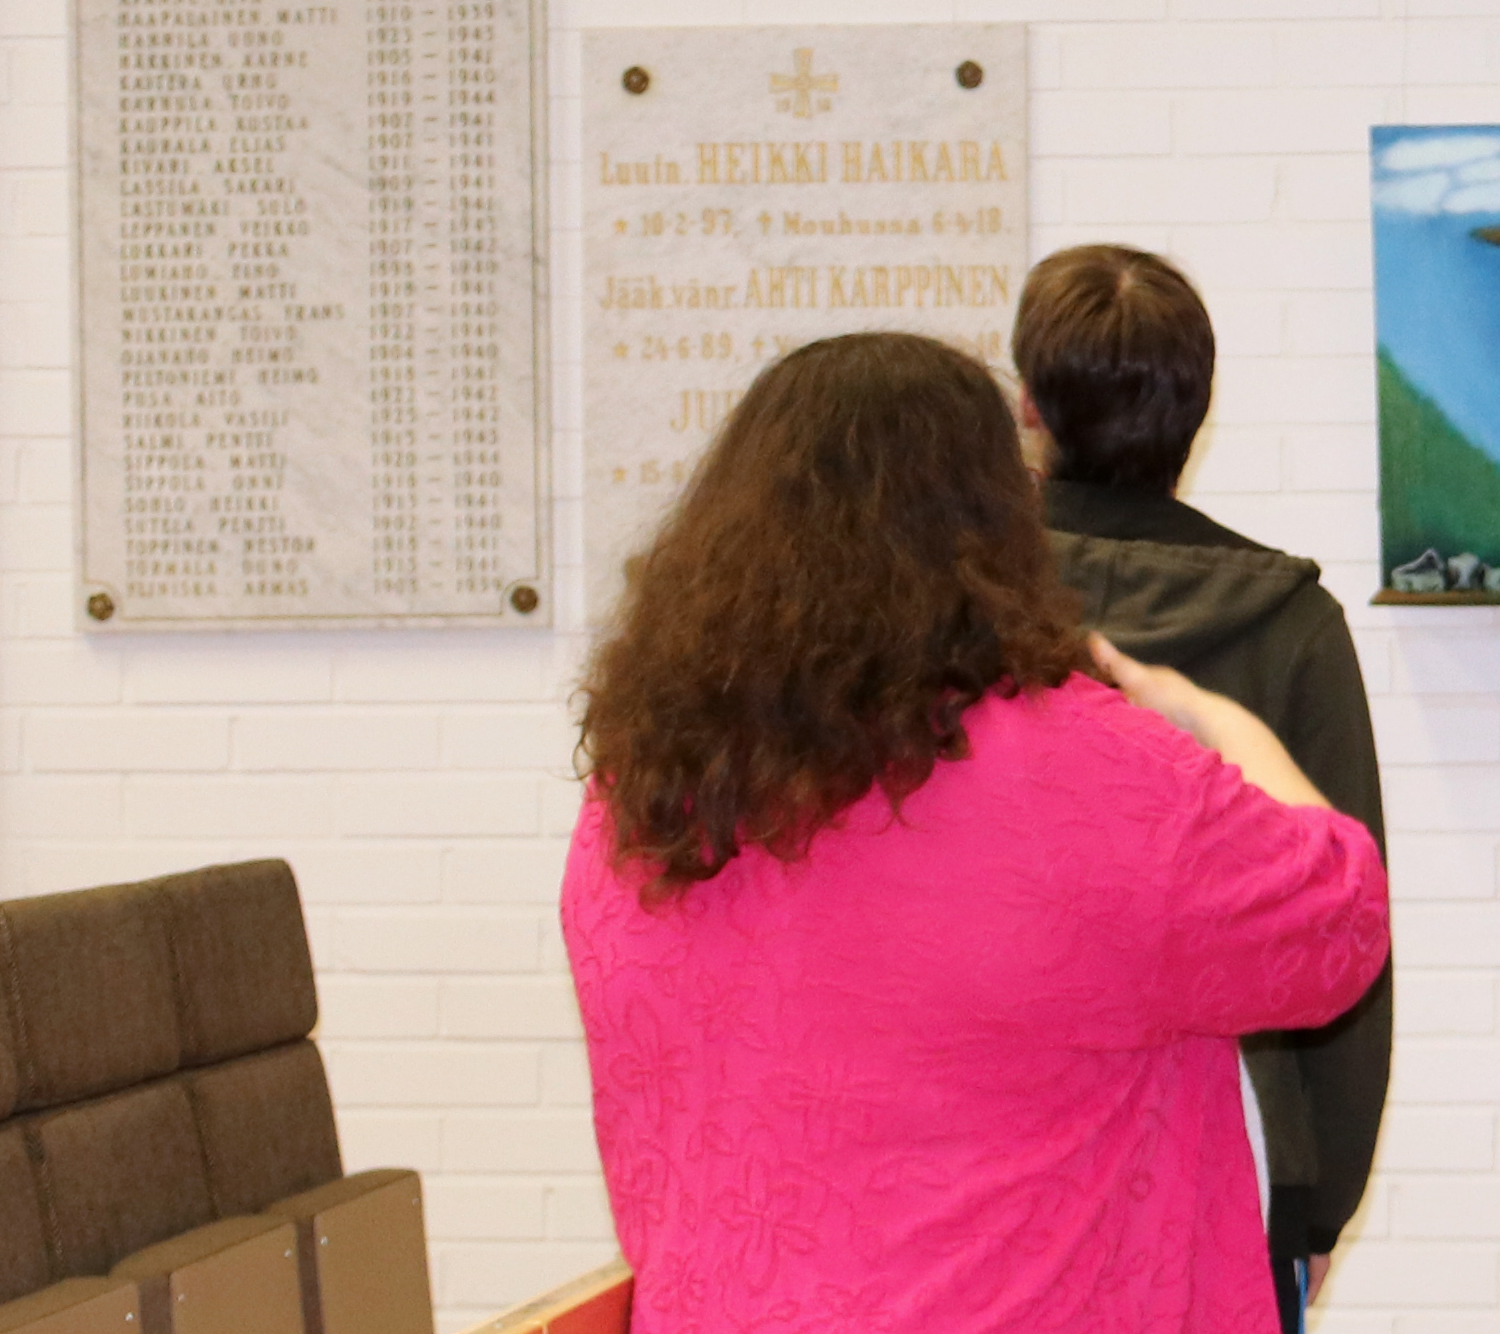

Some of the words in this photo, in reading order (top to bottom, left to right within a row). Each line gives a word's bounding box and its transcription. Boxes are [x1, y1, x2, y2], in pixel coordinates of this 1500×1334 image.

[697, 141, 827, 185] HEIKKI
[841, 140, 1008, 184] HAIKARA
[745, 265, 820, 309] AHTI
[828, 264, 1010, 308] KARPPINEN
